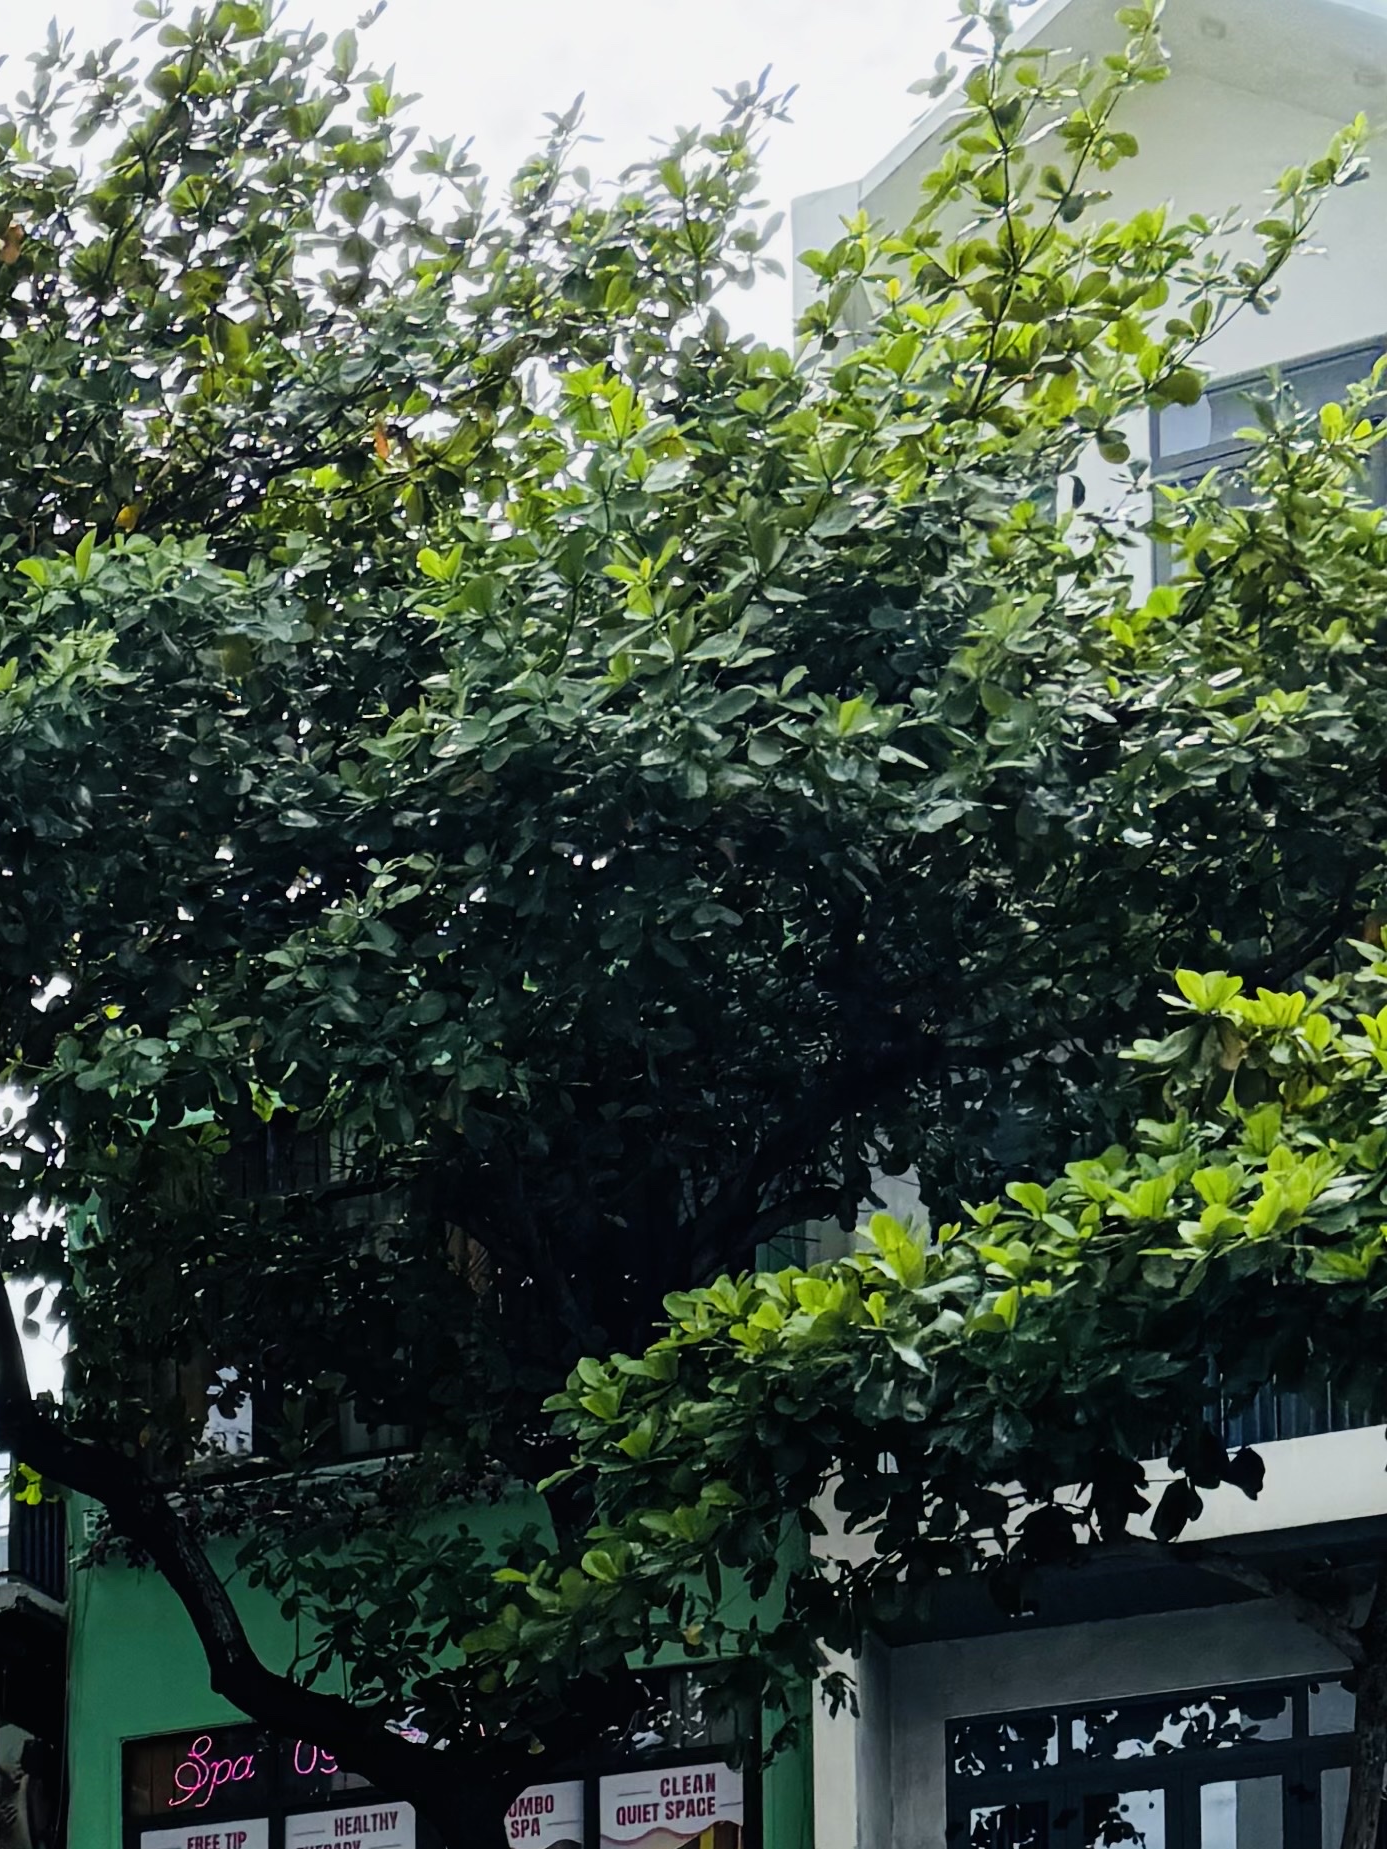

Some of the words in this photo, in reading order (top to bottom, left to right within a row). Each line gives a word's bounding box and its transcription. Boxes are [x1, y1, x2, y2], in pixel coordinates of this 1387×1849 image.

[168, 1735, 256, 1808] Spa
[660, 1773, 716, 1799] CLEAN
[508, 1795, 554, 1818] OMBO
[616, 1802, 661, 1826] QUIET
[665, 1796, 716, 1820] SPACE
[334, 1811, 398, 1837] HEALTHY
[510, 1817, 541, 1839] SPA
